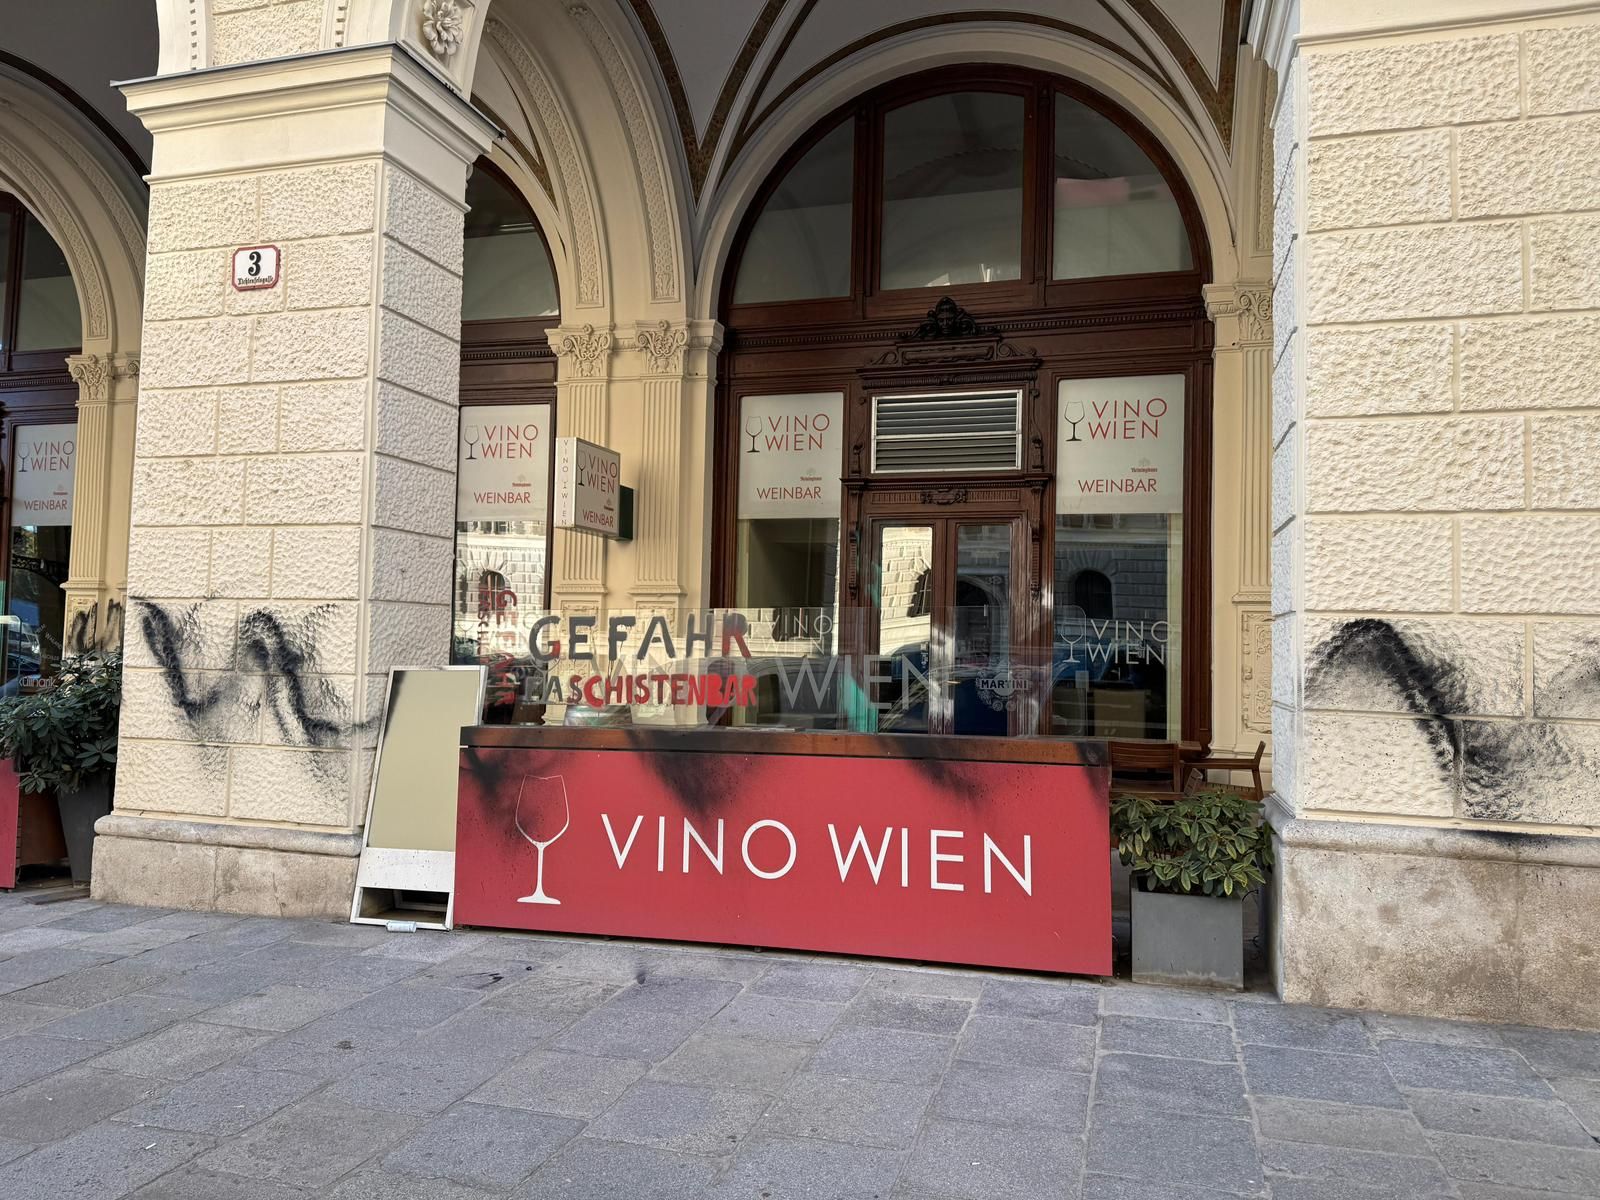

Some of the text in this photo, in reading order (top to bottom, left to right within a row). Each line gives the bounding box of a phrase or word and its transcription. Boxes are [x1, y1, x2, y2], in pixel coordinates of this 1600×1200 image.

[248, 251, 261, 276] 3
[1092, 398, 1167, 419] VINO
[484, 424, 538, 441] VINO
[768, 413, 830, 432] VINO
[1088, 419, 1159, 440] WIEN
[33, 440, 75, 456] VINO
[481, 442, 532, 459] WIEN
[765, 433, 823, 451] WIEN
[31, 456, 70, 472] WIEN
[588, 454, 618, 479] VINO
[586, 471, 615, 495] WIEN
[756, 486, 822, 500] WEINBAR
[1077, 479, 1157, 494] WEINBAR
[24, 499, 68, 511] WEINBAR
[473, 492, 531, 504] WEINBAR
[582, 509, 614, 528] WEINBAR
[765, 614, 833, 636] VINO
[1091, 619, 1171, 642] VINO
[529, 612, 751, 661] GEFAHR
[1087, 642, 1165, 665] WIEN
[525, 673, 758, 707] FASCHISTENBAR
[776, 653, 945, 711] WIEN
[981, 679, 1028, 689] MARTINI
[601, 814, 1032, 897] VINO WIEN
